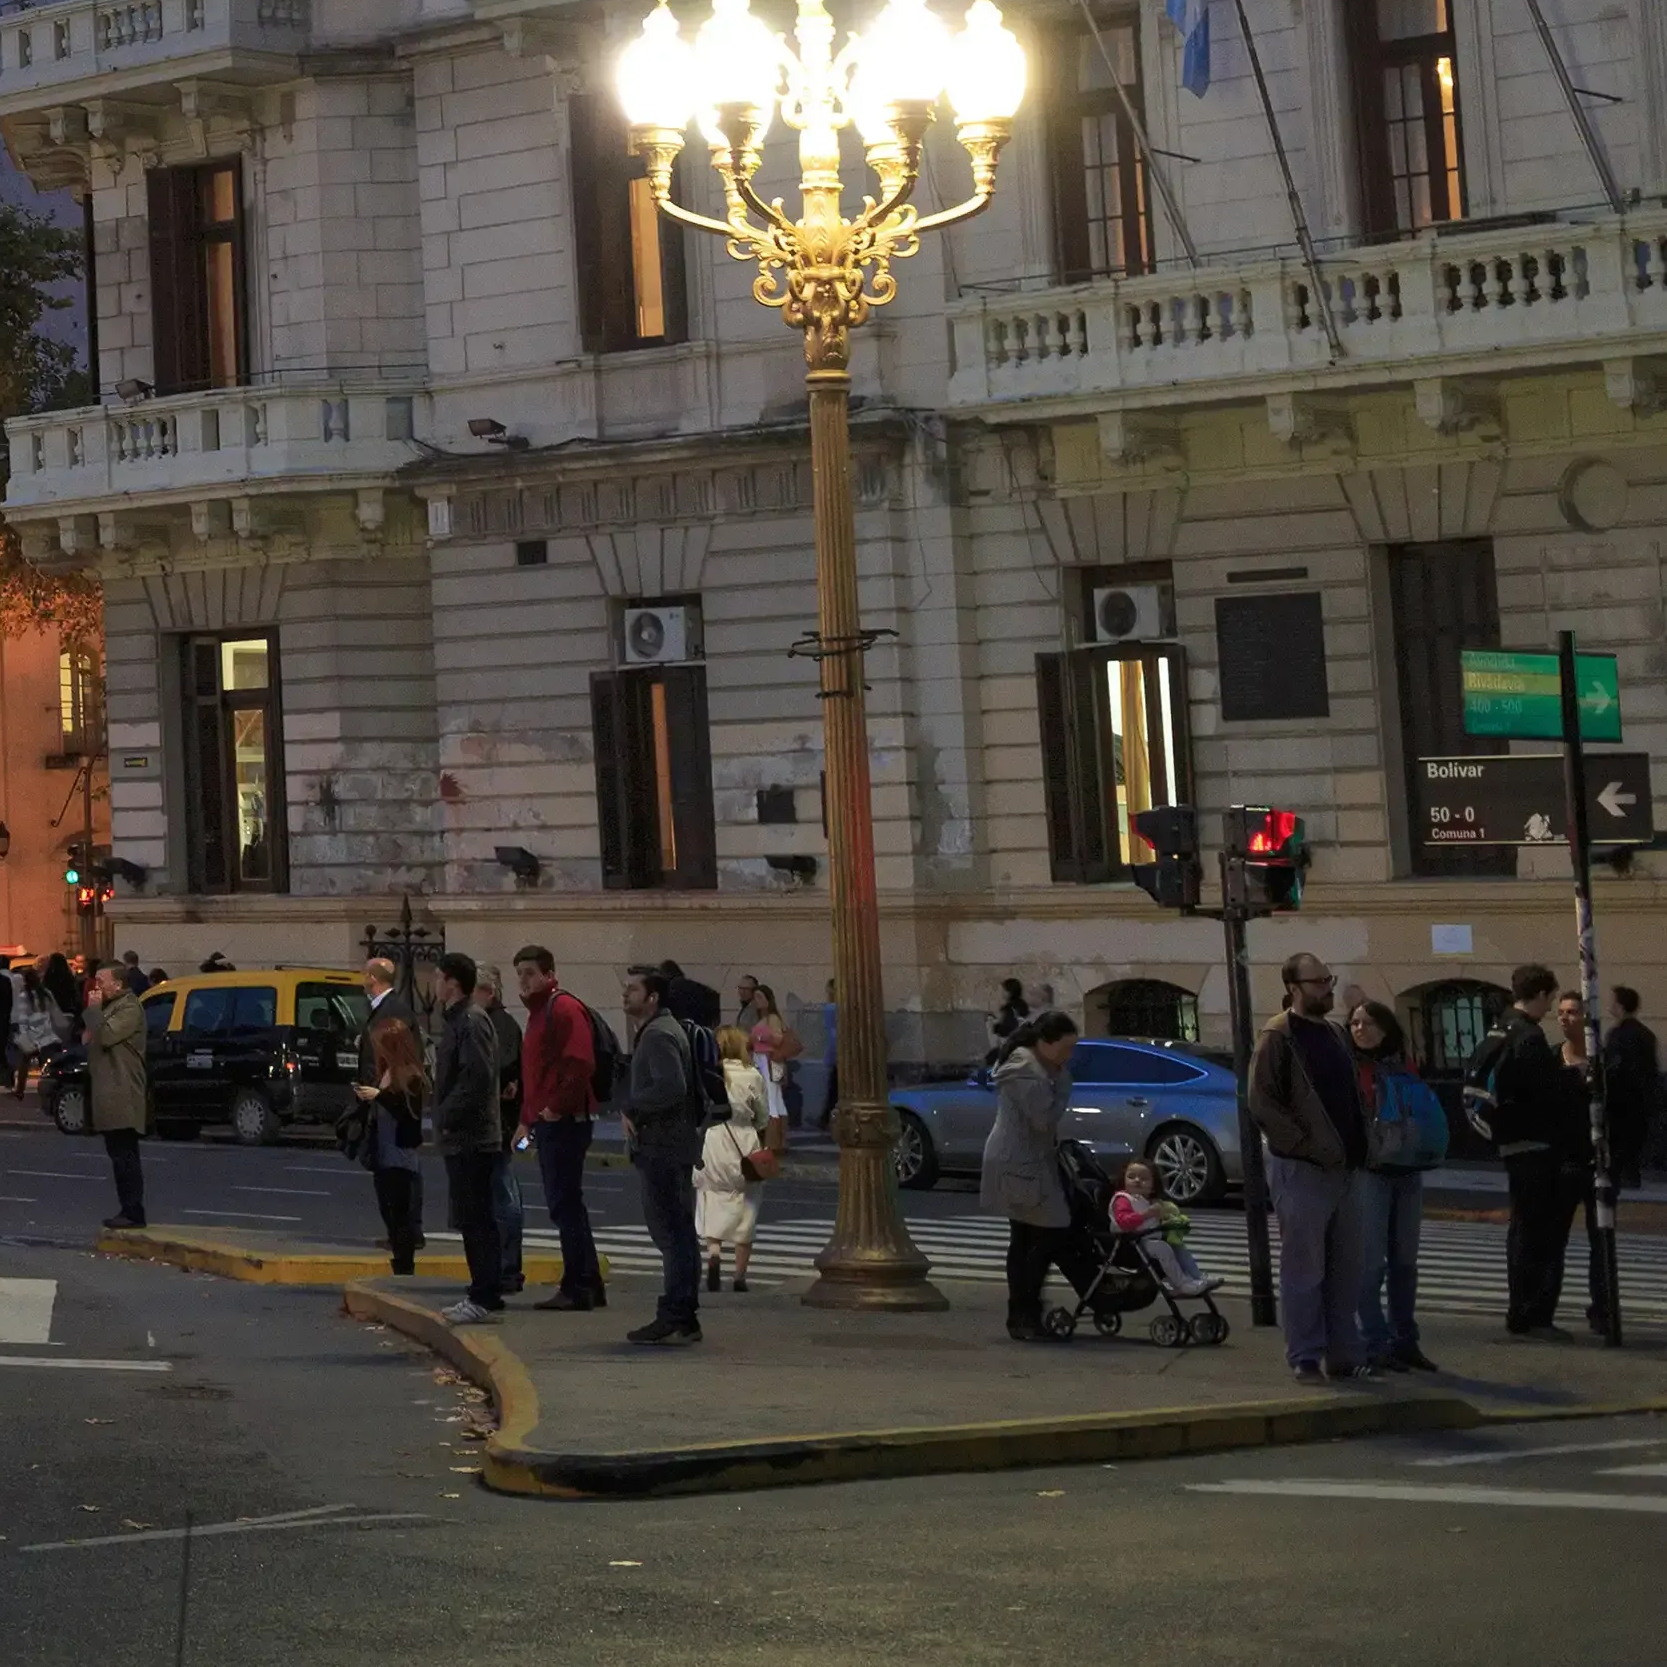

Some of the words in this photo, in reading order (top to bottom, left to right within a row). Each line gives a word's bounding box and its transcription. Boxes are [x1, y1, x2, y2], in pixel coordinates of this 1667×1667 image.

[1426, 762, 1484, 778] Bolívar
[1430, 805, 1450, 822] 50
[1464, 805, 1475, 822] 0
[1431, 828, 1476, 839] Comuna
[1479, 827, 1485, 838] 1
